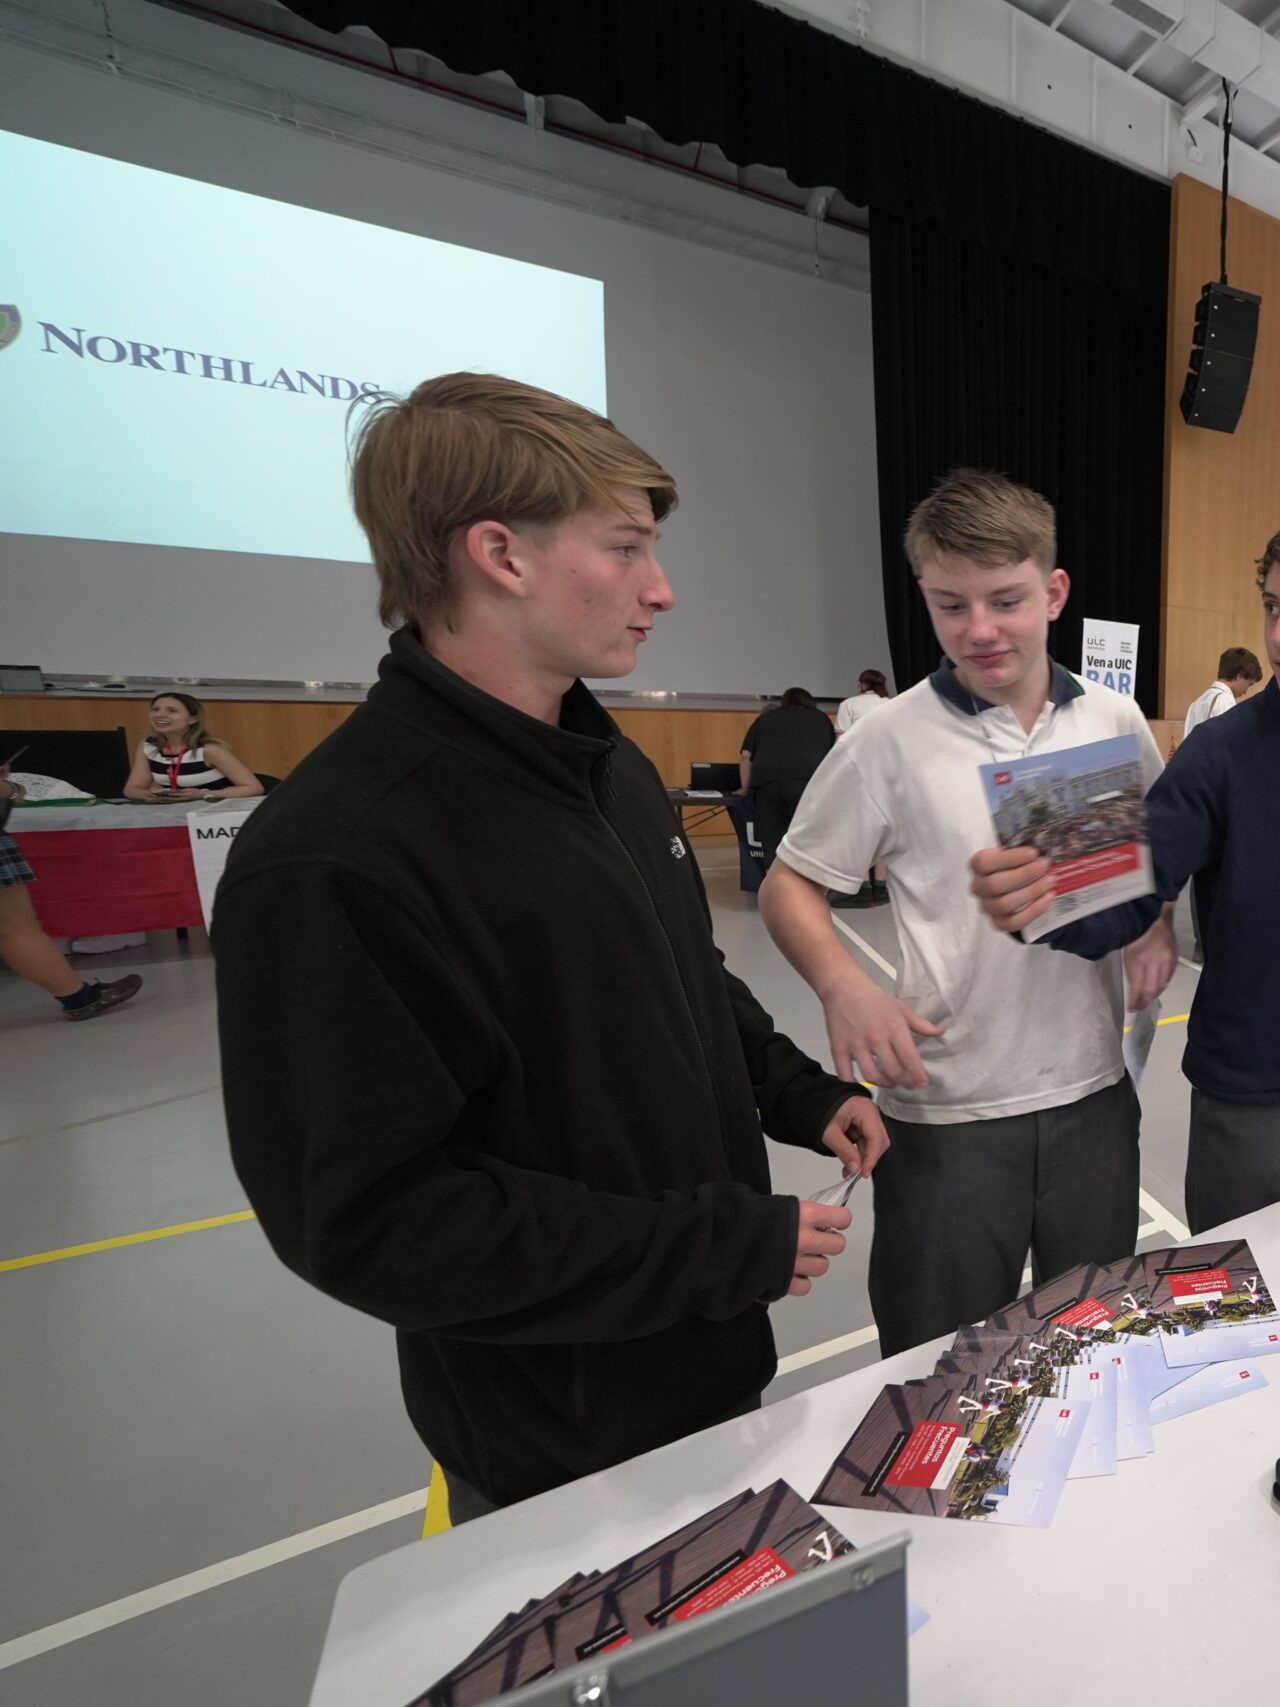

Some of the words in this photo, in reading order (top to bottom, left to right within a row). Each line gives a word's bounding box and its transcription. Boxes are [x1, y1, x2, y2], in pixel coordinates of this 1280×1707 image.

[37, 320, 384, 405] NORTHLANDS
[1087, 655, 1105, 667] Ven
[1107, 660, 1113, 668] a
[1115, 658, 1132, 670] UIC
[921, 1426, 948, 1465] Frecuentes
[931, 1426, 957, 1463] Preguntas
